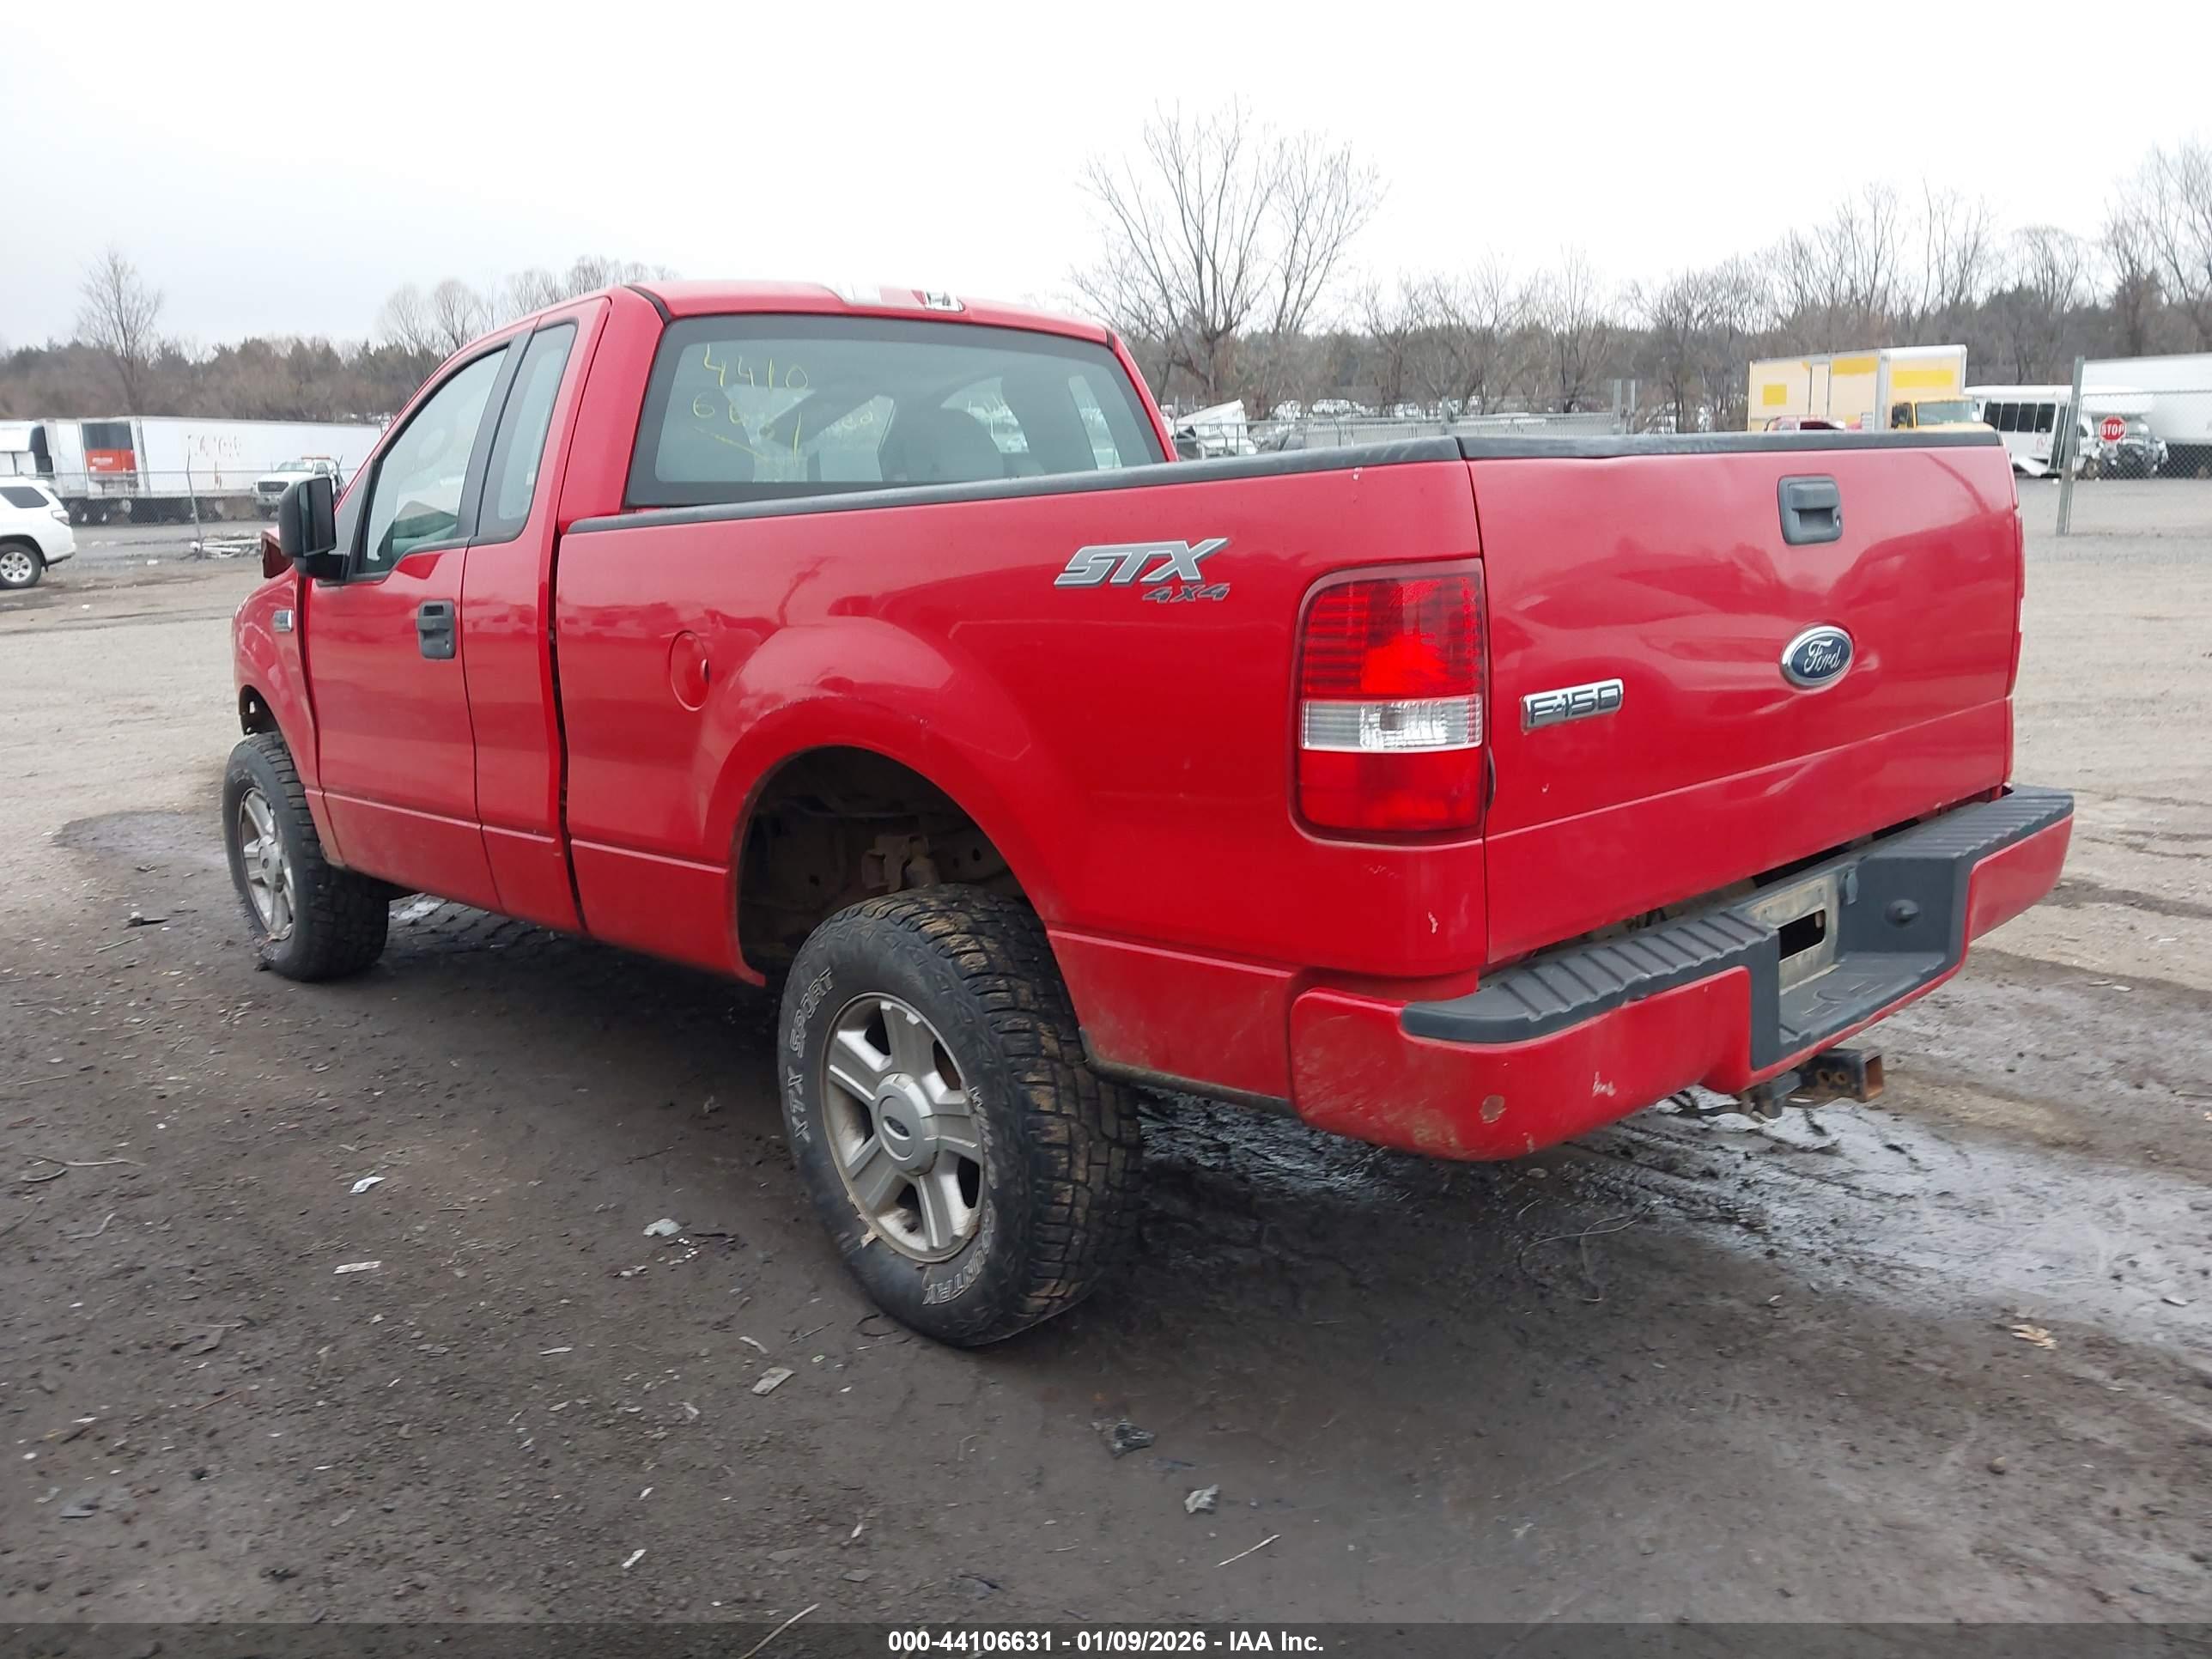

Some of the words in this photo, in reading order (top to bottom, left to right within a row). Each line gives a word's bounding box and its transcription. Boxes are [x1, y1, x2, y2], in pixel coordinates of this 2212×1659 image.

[703, 343, 809, 391] 4410
[2101, 423, 2124, 436] STOP
[1054, 537, 1231, 589] STX
[1804, 640, 1841, 673] Ford
[789, 967, 835, 1058] SPORT
[787, 1066, 811, 1143] XTX
